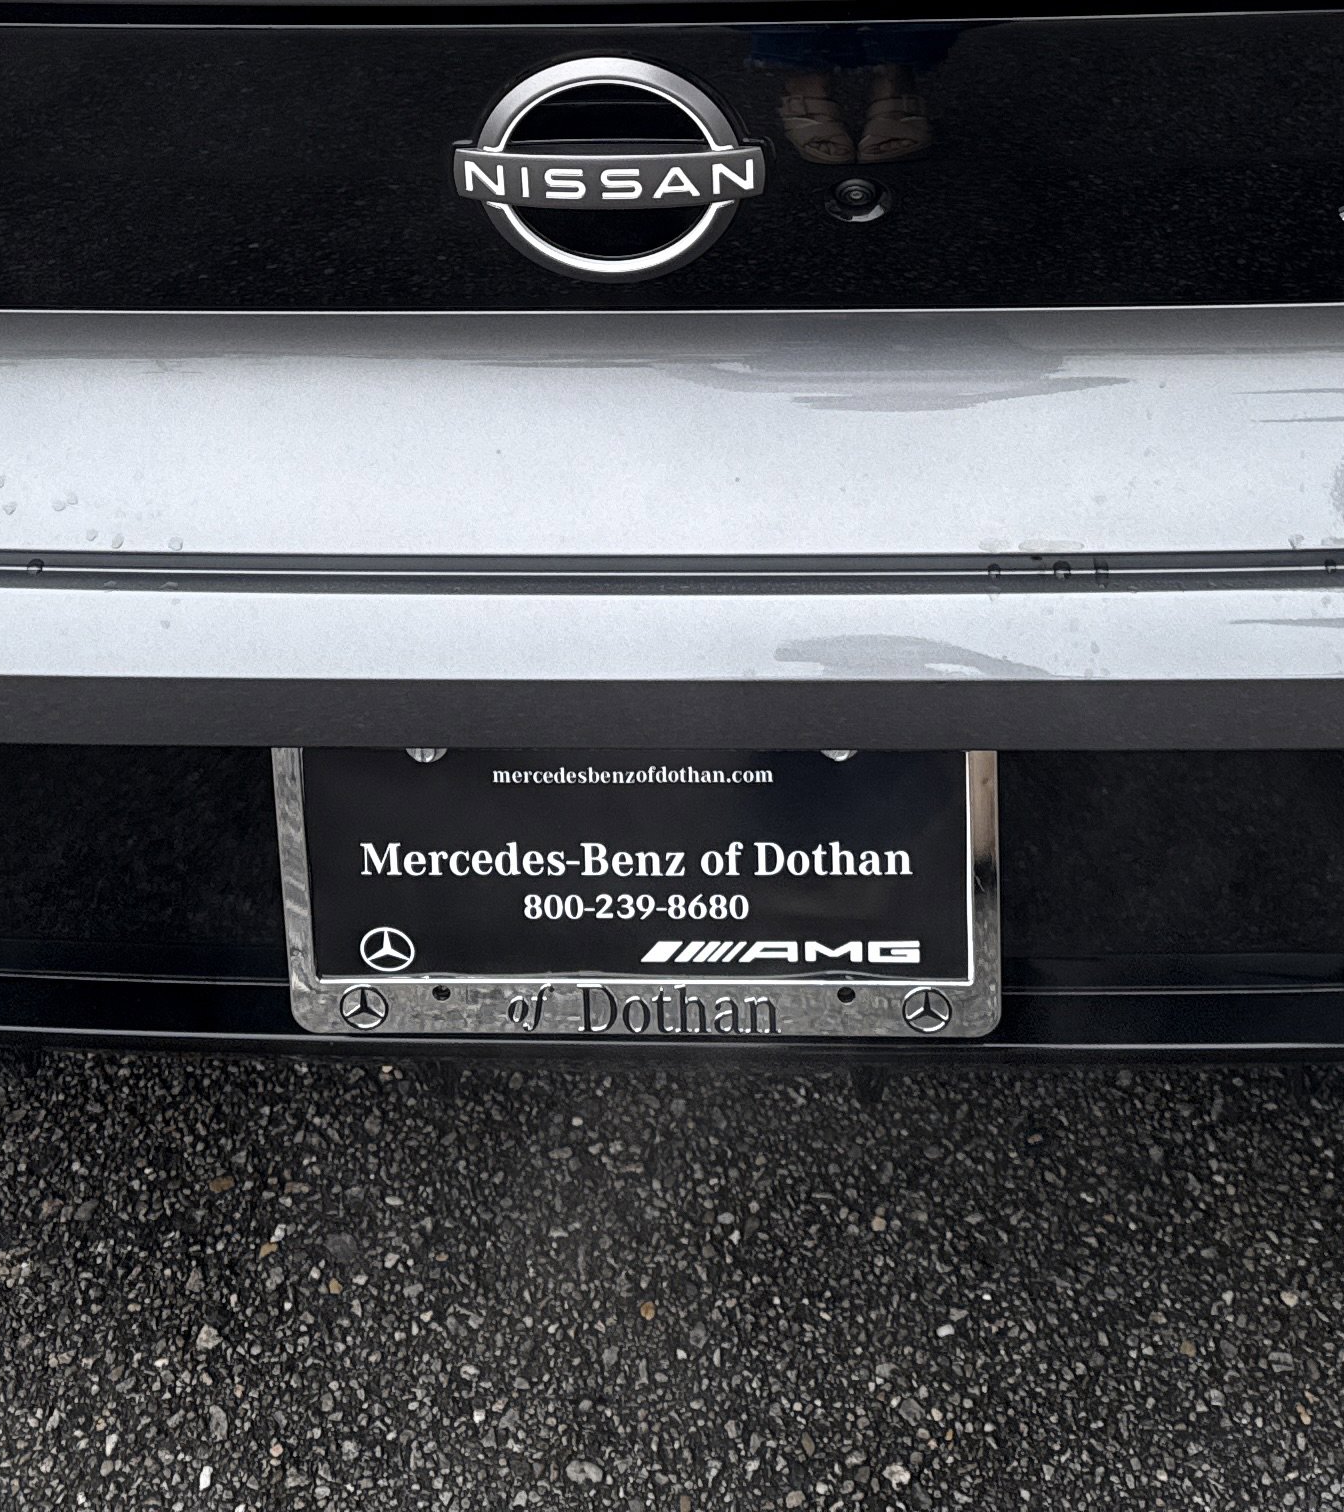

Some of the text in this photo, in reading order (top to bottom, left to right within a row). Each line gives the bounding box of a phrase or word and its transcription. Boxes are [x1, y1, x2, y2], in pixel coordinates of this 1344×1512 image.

[463, 158, 755, 200] NISSAN
[492, 765, 774, 785] mercedesbenzofdothan.com
[359, 841, 914, 878] Mercedes-Benz of Dothan
[522, 893, 750, 921] 800-239-8680
[739, 940, 921, 964] AMG
[507, 982, 782, 1034] of Dothan
